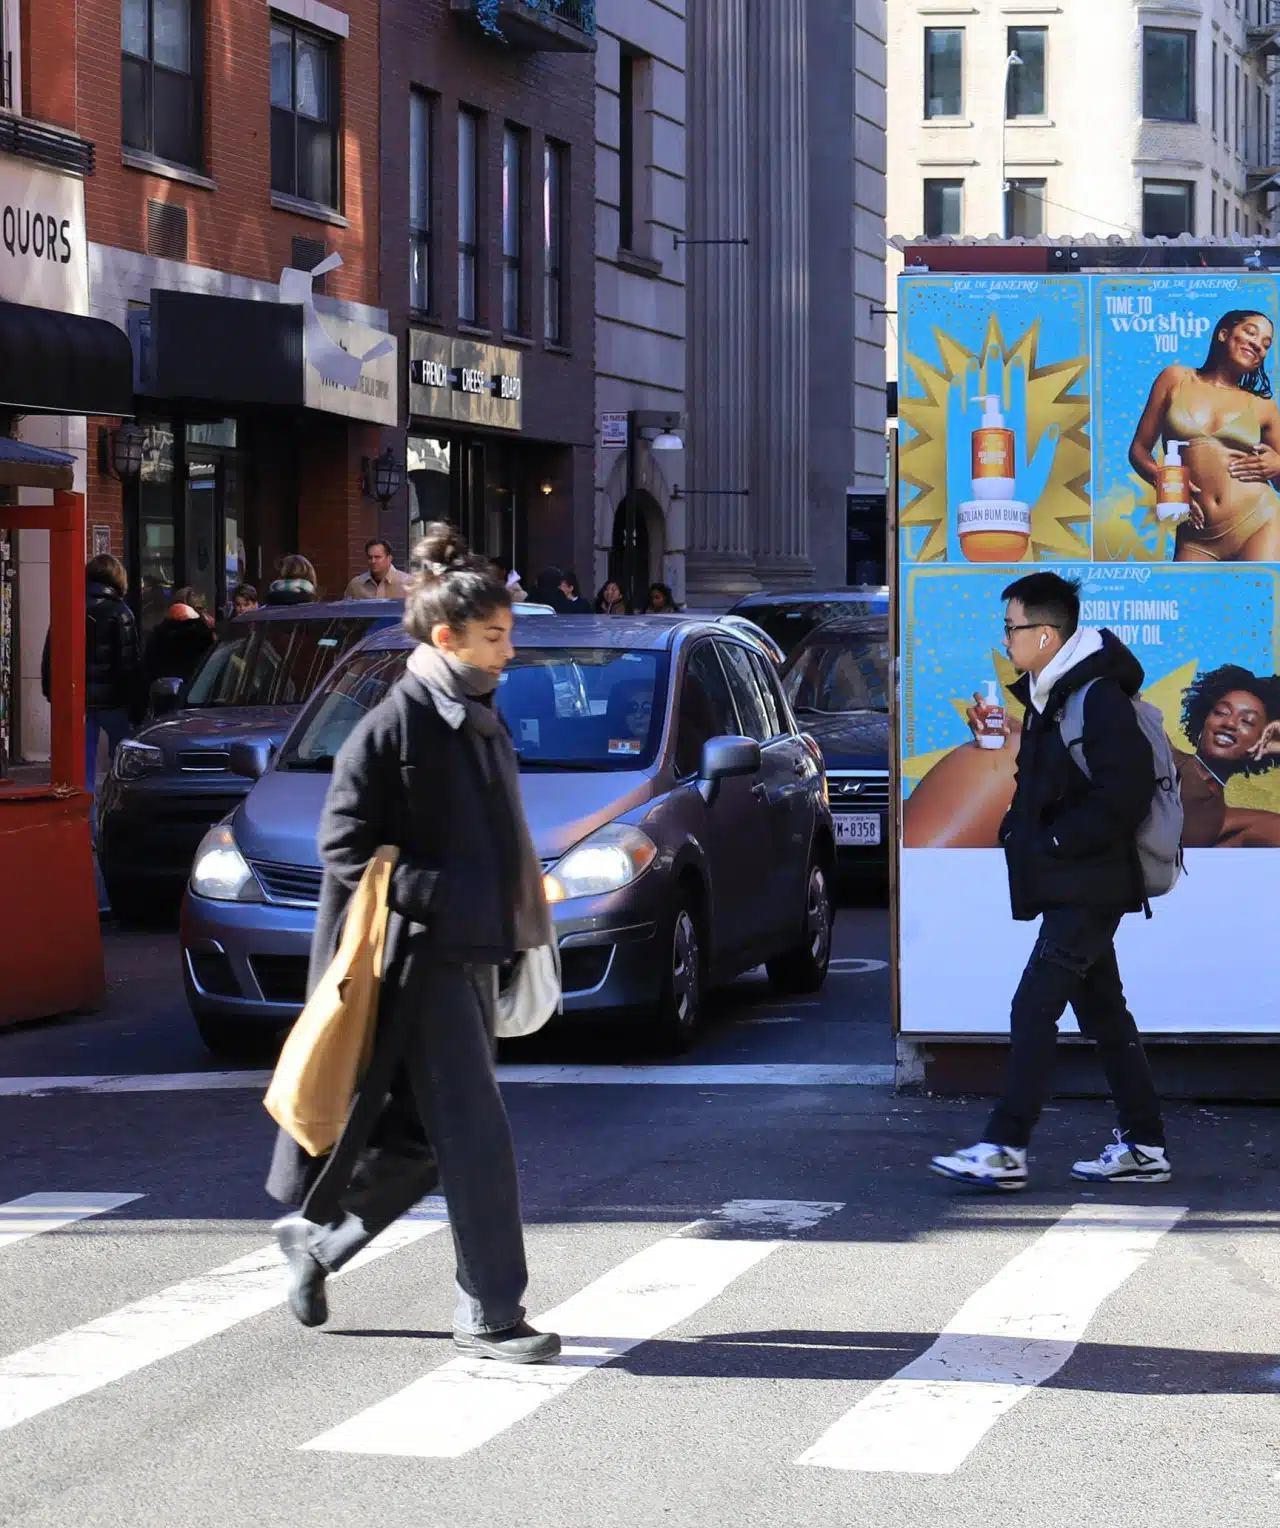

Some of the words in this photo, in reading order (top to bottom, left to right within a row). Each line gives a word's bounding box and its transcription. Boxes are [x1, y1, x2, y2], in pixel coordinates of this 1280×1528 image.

[3, 205, 71, 264] QUORS
[950, 280, 972, 293] SOL
[1148, 279, 1171, 292] SOL
[1105, 296, 1134, 315] TIME
[1137, 296, 1152, 315] TO
[1110, 312, 1210, 338] worship
[1154, 334, 1178, 353] YOU
[422, 360, 447, 387] FRENCH
[462, 368, 484, 394] CHEESE
[501, 375, 520, 400] BOARD
[985, 509, 1002, 521] BUM
[1004, 509, 1019, 521] BUM
[1079, 600, 1121, 621] ISIBLY
[1123, 600, 1179, 621] FIRMING
[1142, 624, 1164, 645] OIL
